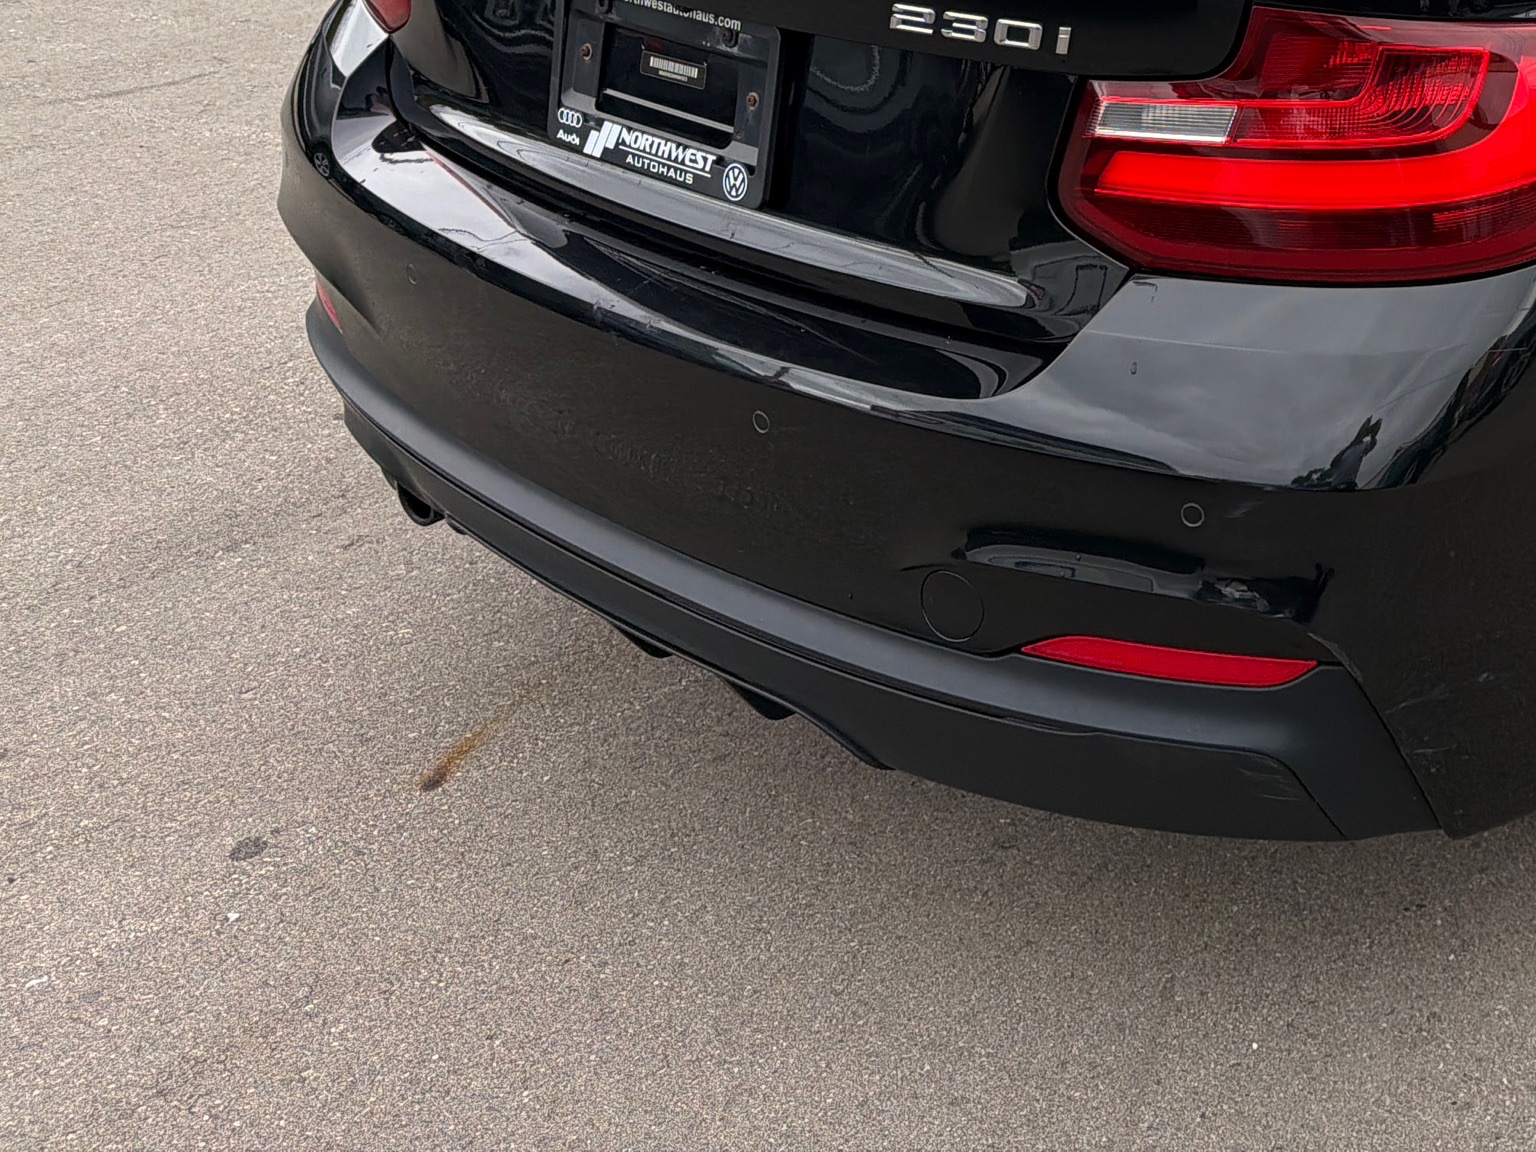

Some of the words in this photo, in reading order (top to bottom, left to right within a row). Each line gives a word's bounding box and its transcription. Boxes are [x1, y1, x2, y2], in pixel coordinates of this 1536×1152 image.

[889, 3, 1072, 55] 230i
[556, 129, 580, 146] Audi
[618, 127, 717, 173] NORTHWEST
[625, 154, 695, 185] AUTOHAUS
